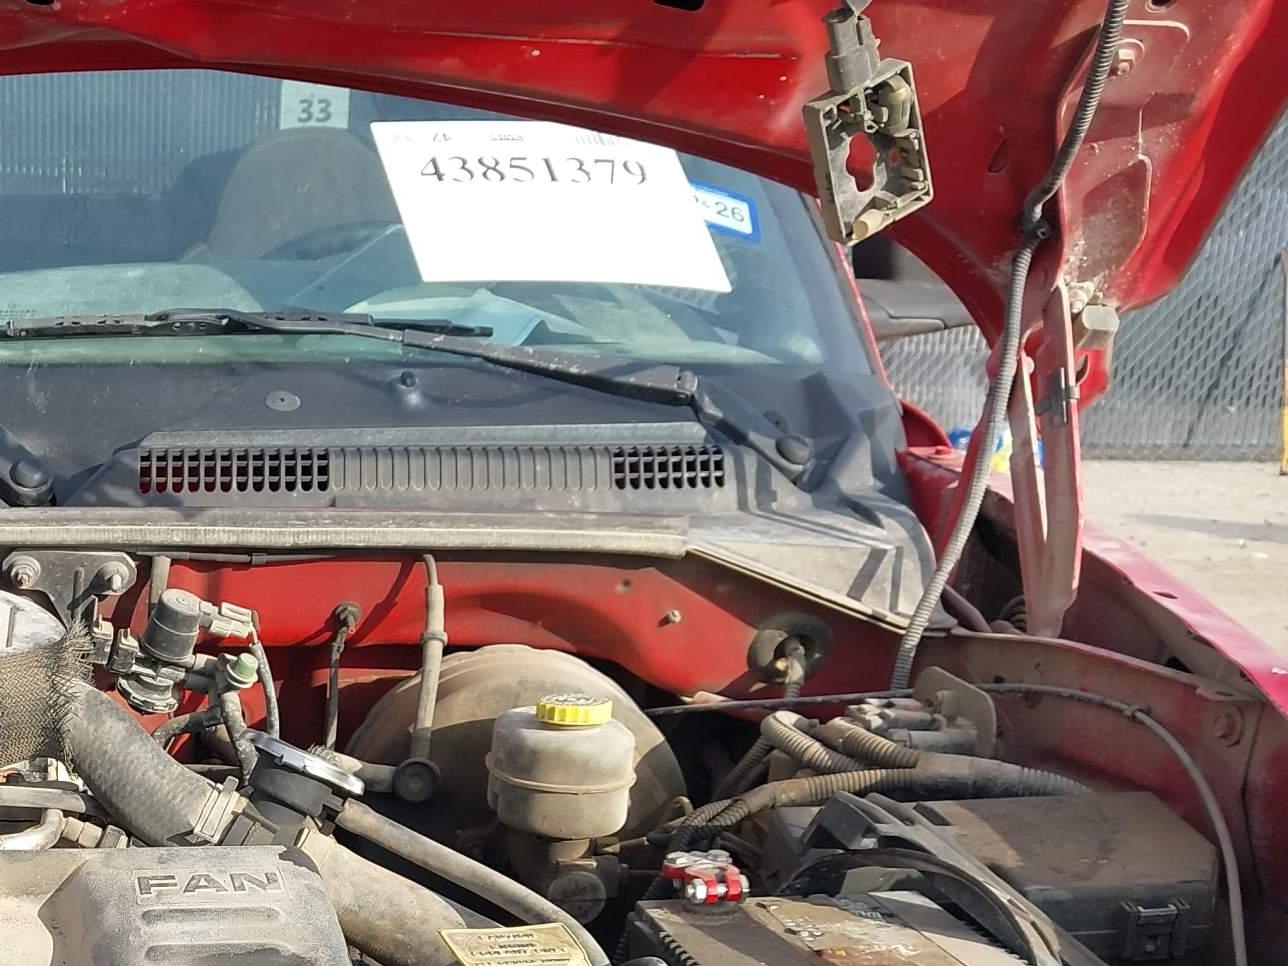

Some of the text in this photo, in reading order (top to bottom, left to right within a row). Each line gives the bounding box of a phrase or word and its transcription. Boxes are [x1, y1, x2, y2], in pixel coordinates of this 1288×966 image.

[297, 98, 332, 123] 33
[420, 155, 648, 185] 43851379
[714, 201, 745, 222] 26
[137, 872, 282, 895] FAN
